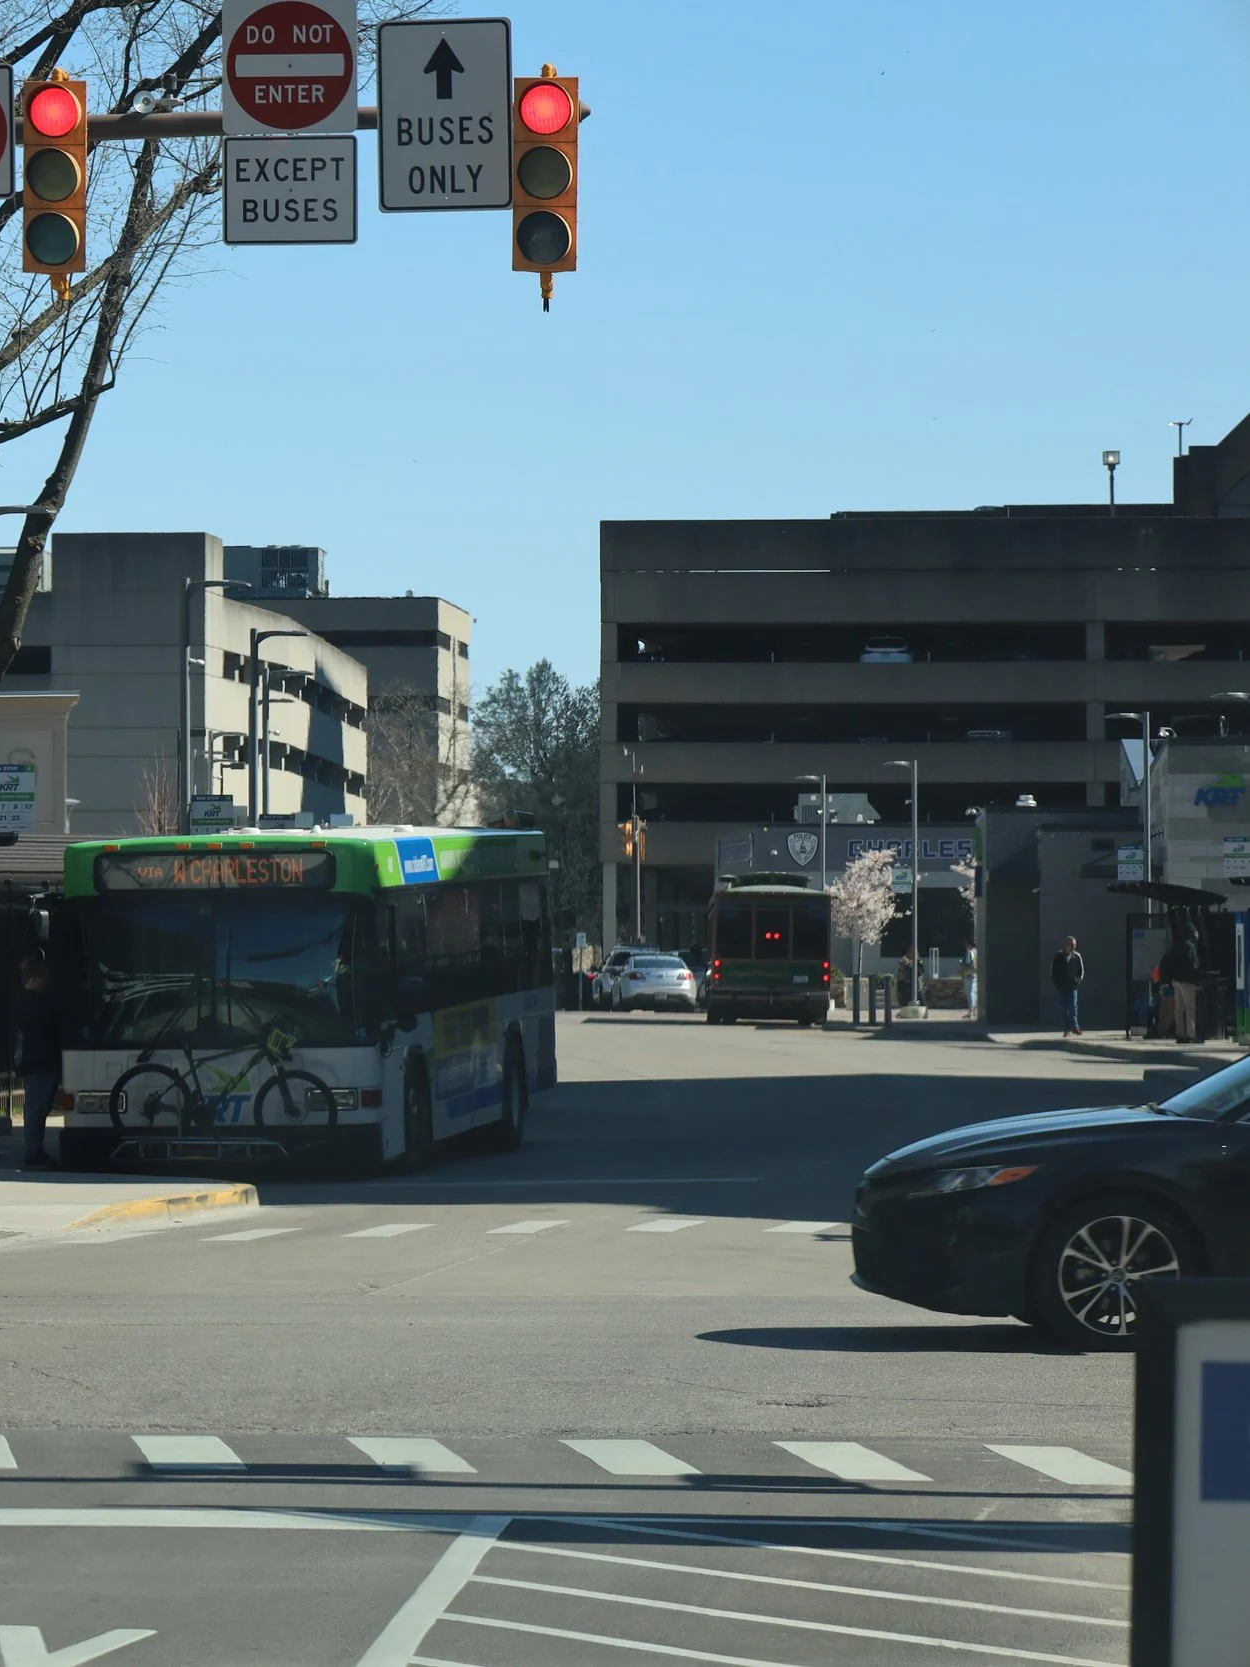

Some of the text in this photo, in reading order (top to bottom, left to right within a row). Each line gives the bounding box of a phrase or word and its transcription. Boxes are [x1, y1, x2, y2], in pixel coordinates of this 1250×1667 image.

[246, 24, 334, 44] DO NOT
[254, 84, 325, 104] ENTER
[396, 115, 494, 147] BUSES
[235, 157, 345, 183] EXCEPT
[408, 164, 483, 195] ONLY
[242, 198, 338, 223] BUSES
[204, 810, 222, 818] KRT
[847, 838, 973, 859] CHARLES
[137, 858, 303, 885] VIA W CHARLESTON
